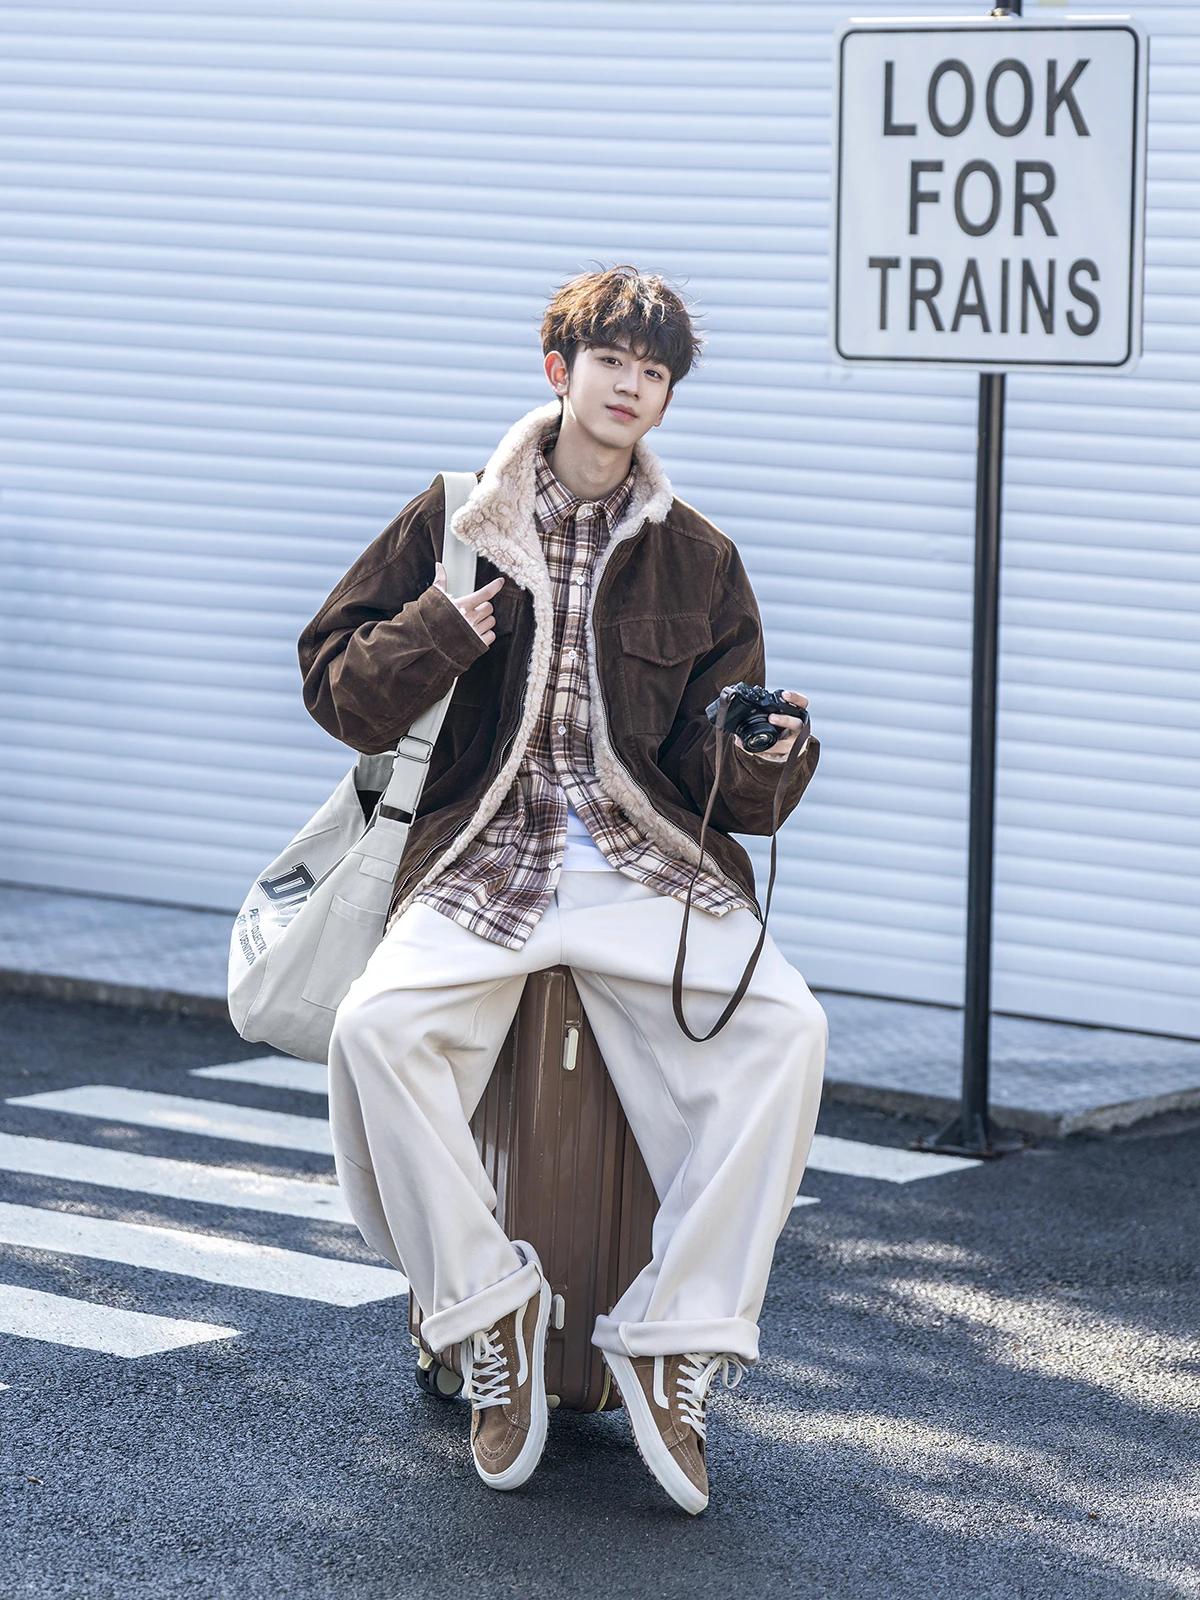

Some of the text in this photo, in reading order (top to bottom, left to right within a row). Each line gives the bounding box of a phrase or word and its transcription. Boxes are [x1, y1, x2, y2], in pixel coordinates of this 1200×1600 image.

[883, 58, 1092, 138] LOOK
[908, 159, 1059, 237] FOR
[868, 256, 1101, 337] TRAINS
